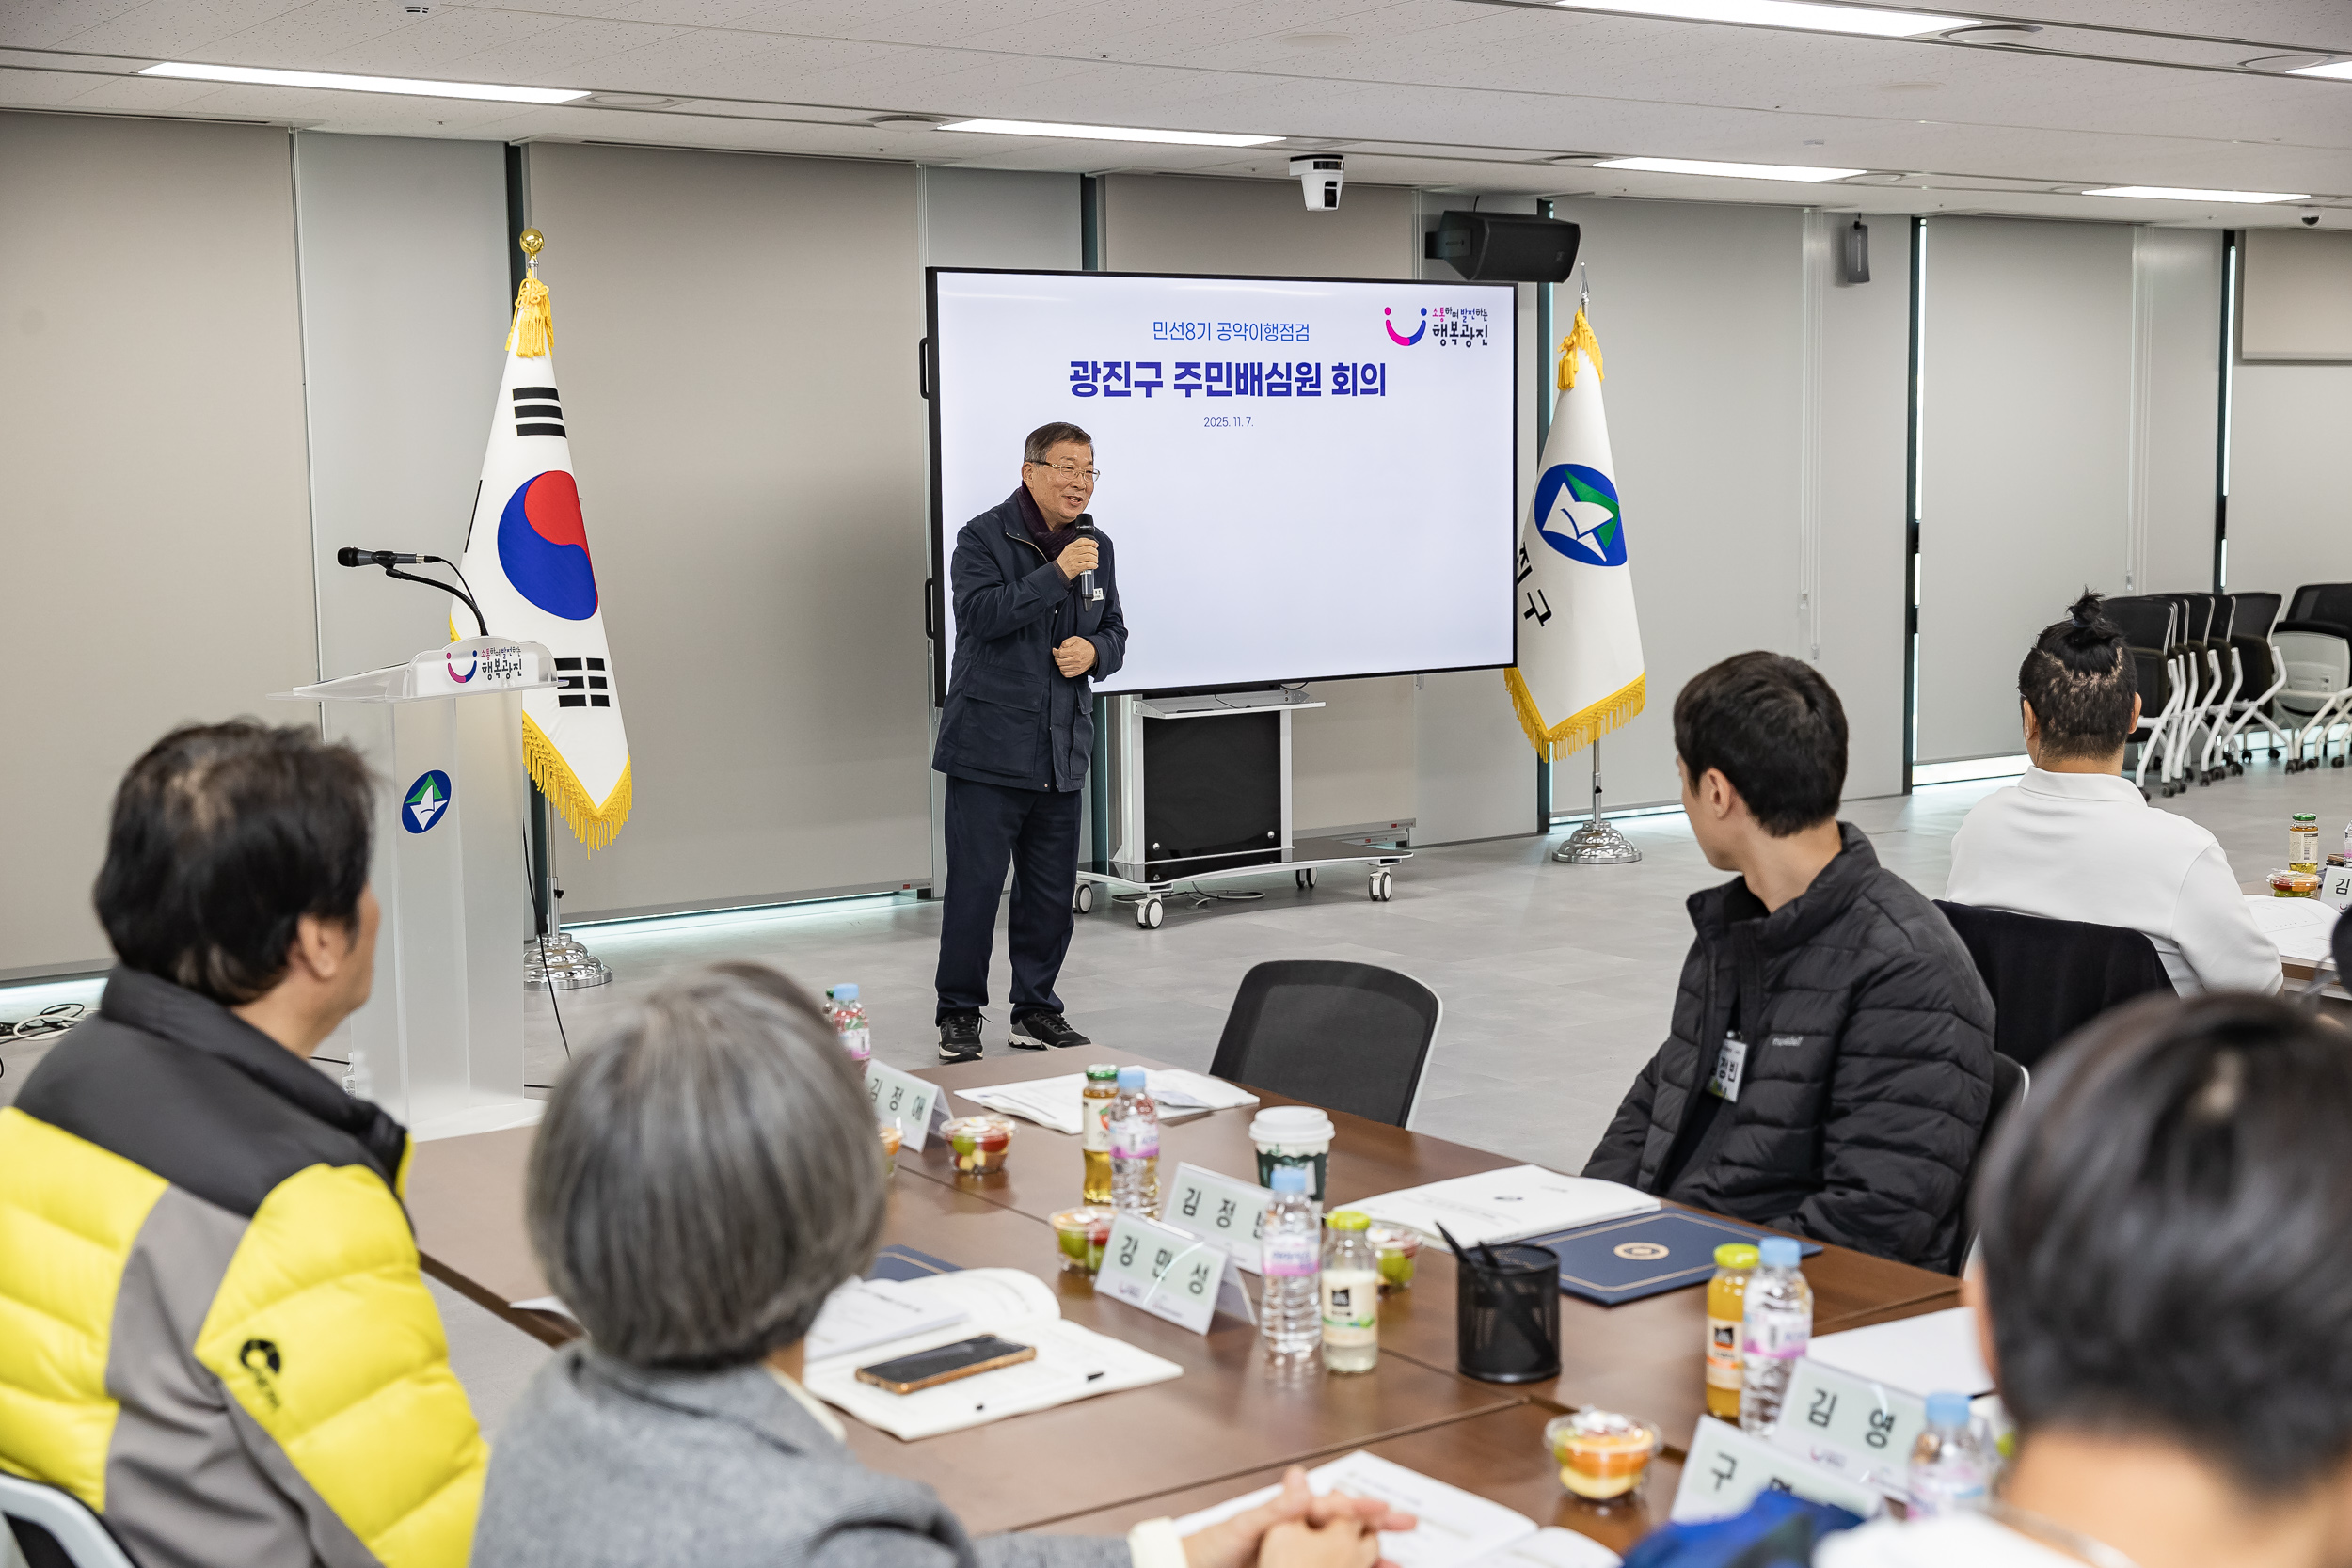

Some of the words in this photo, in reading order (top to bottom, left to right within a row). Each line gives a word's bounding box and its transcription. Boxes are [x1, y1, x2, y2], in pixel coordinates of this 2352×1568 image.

[1432, 307, 1459, 323] 소통하며
[1460, 307, 1488, 323] 발전하는
[1152, 321, 1212, 341] 민선8기
[1216, 322, 1311, 342] 공약이행점검
[1432, 321, 1488, 348] 행복광진
[1069, 360, 1164, 399] 광진구
[1173, 361, 1322, 399] 주민배심원
[1331, 361, 1386, 397] 회의
[1203, 416, 1231, 428] 2025.
[1232, 416, 1244, 428] 11.
[1245, 416, 1254, 428] 7.
[481, 658, 522, 681] 행복광진
[2335, 878, 2351, 895] 김
